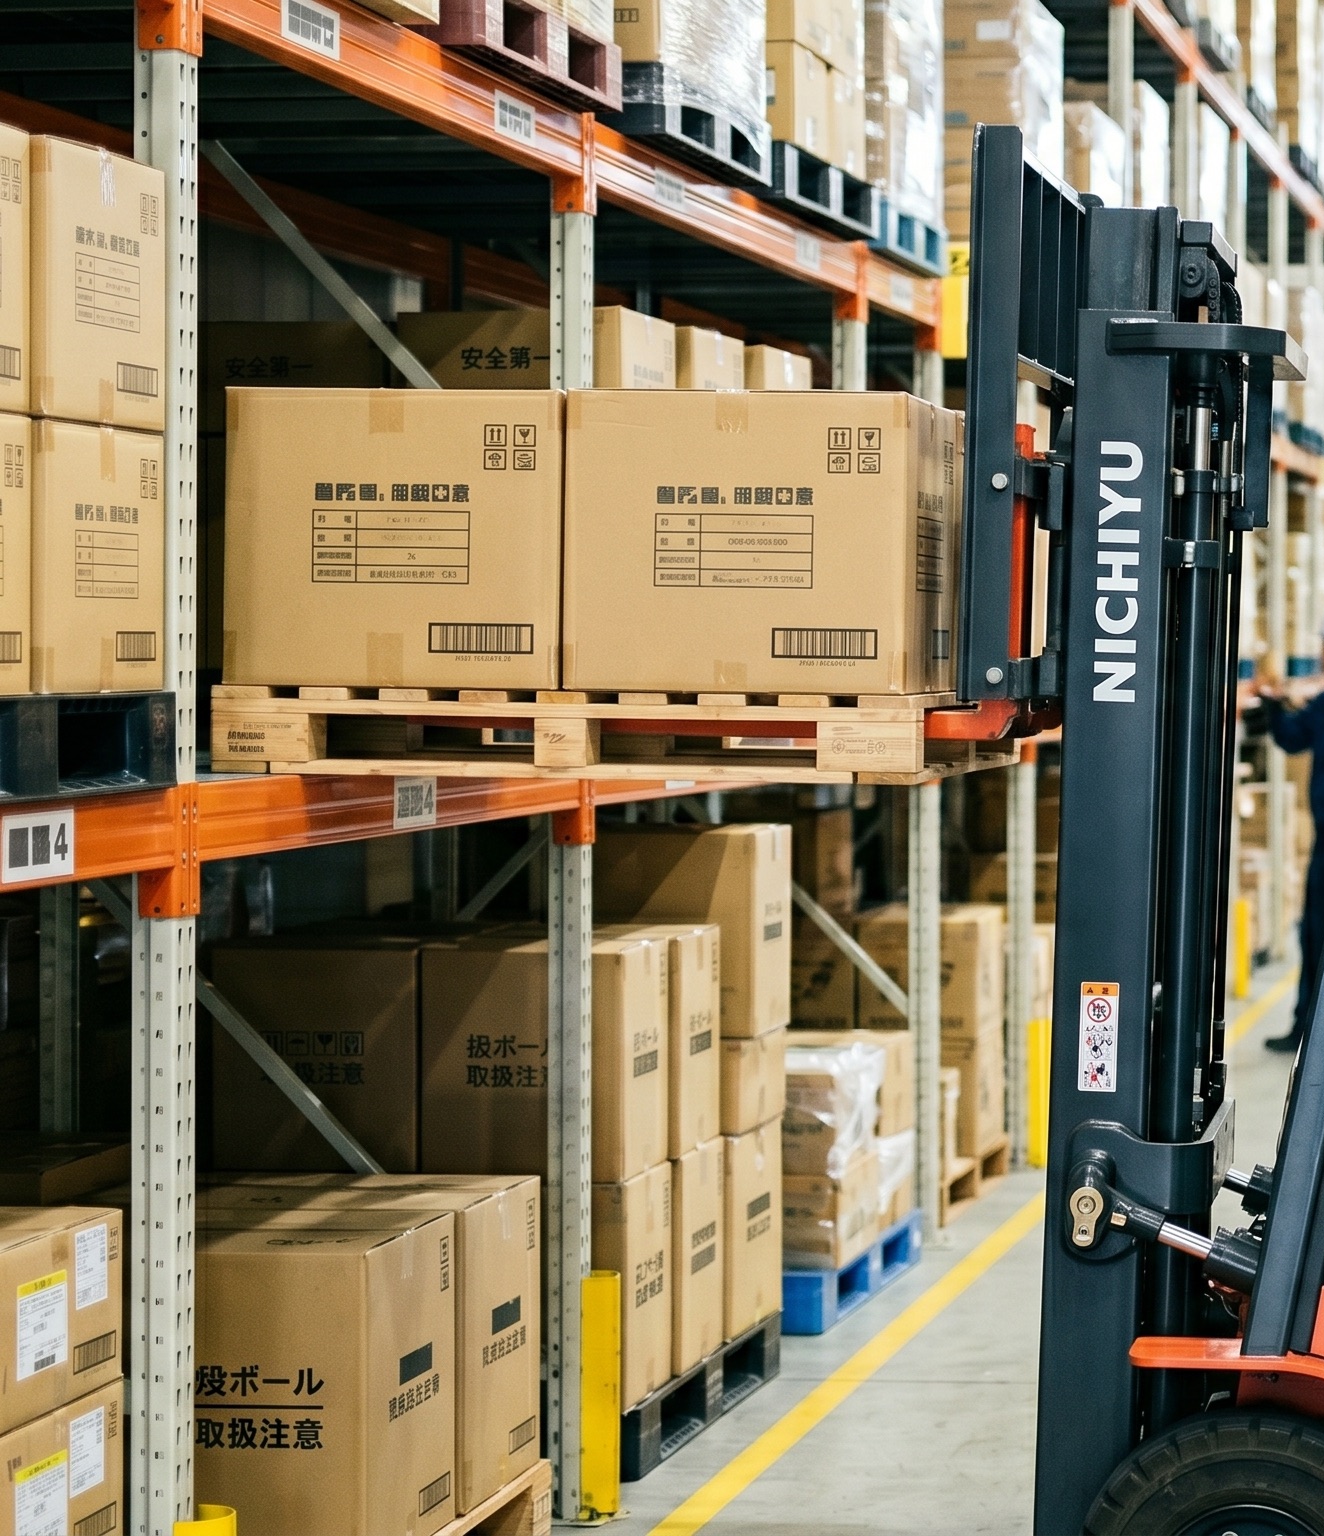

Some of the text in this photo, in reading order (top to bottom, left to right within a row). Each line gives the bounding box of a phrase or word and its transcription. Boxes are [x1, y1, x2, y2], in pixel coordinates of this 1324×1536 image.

[225, 356, 313, 378] 安全第一
[460, 346, 550, 370] 安全第一
[1092, 440, 1144, 703] NICHIYU
[195, 1417, 323, 1450] 取扱注意
